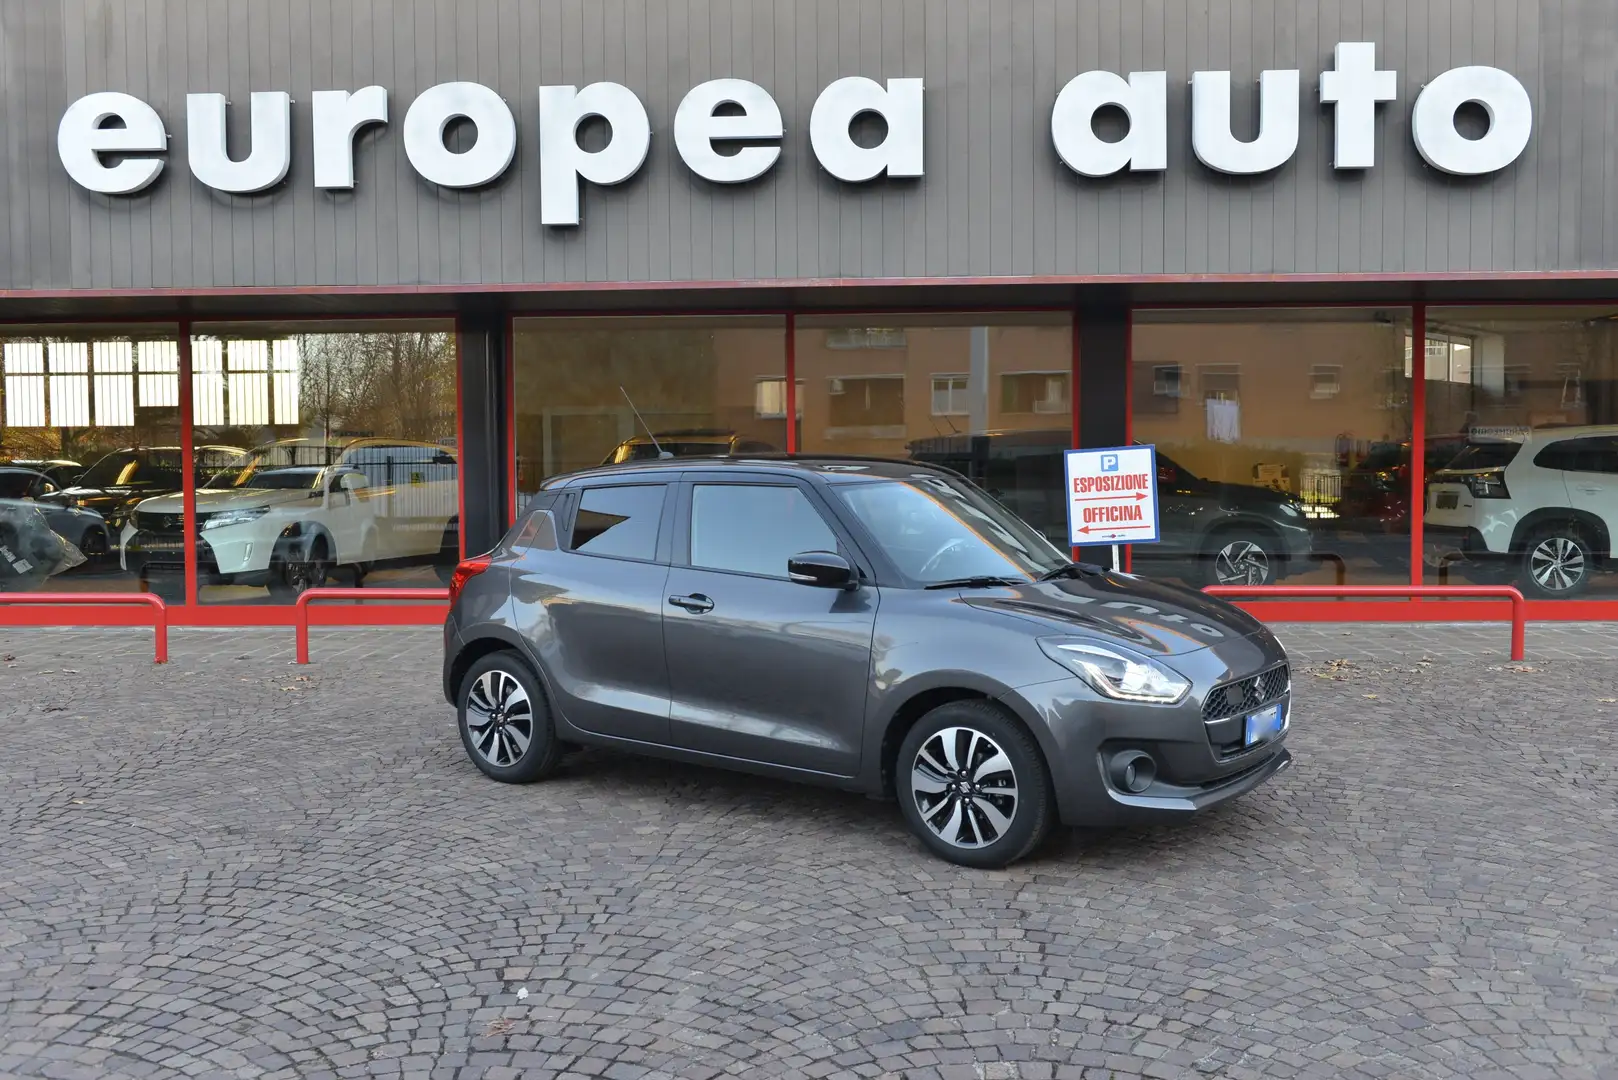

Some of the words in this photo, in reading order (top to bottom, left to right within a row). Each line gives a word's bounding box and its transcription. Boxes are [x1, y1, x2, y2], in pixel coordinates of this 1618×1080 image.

[57, 76, 925, 226] europea
[1050, 41, 1533, 176] auto
[1103, 456, 1116, 470] P
[1073, 474, 1149, 493] ESPOSIZIONE
[1083, 505, 1143, 523] OFFICINA
